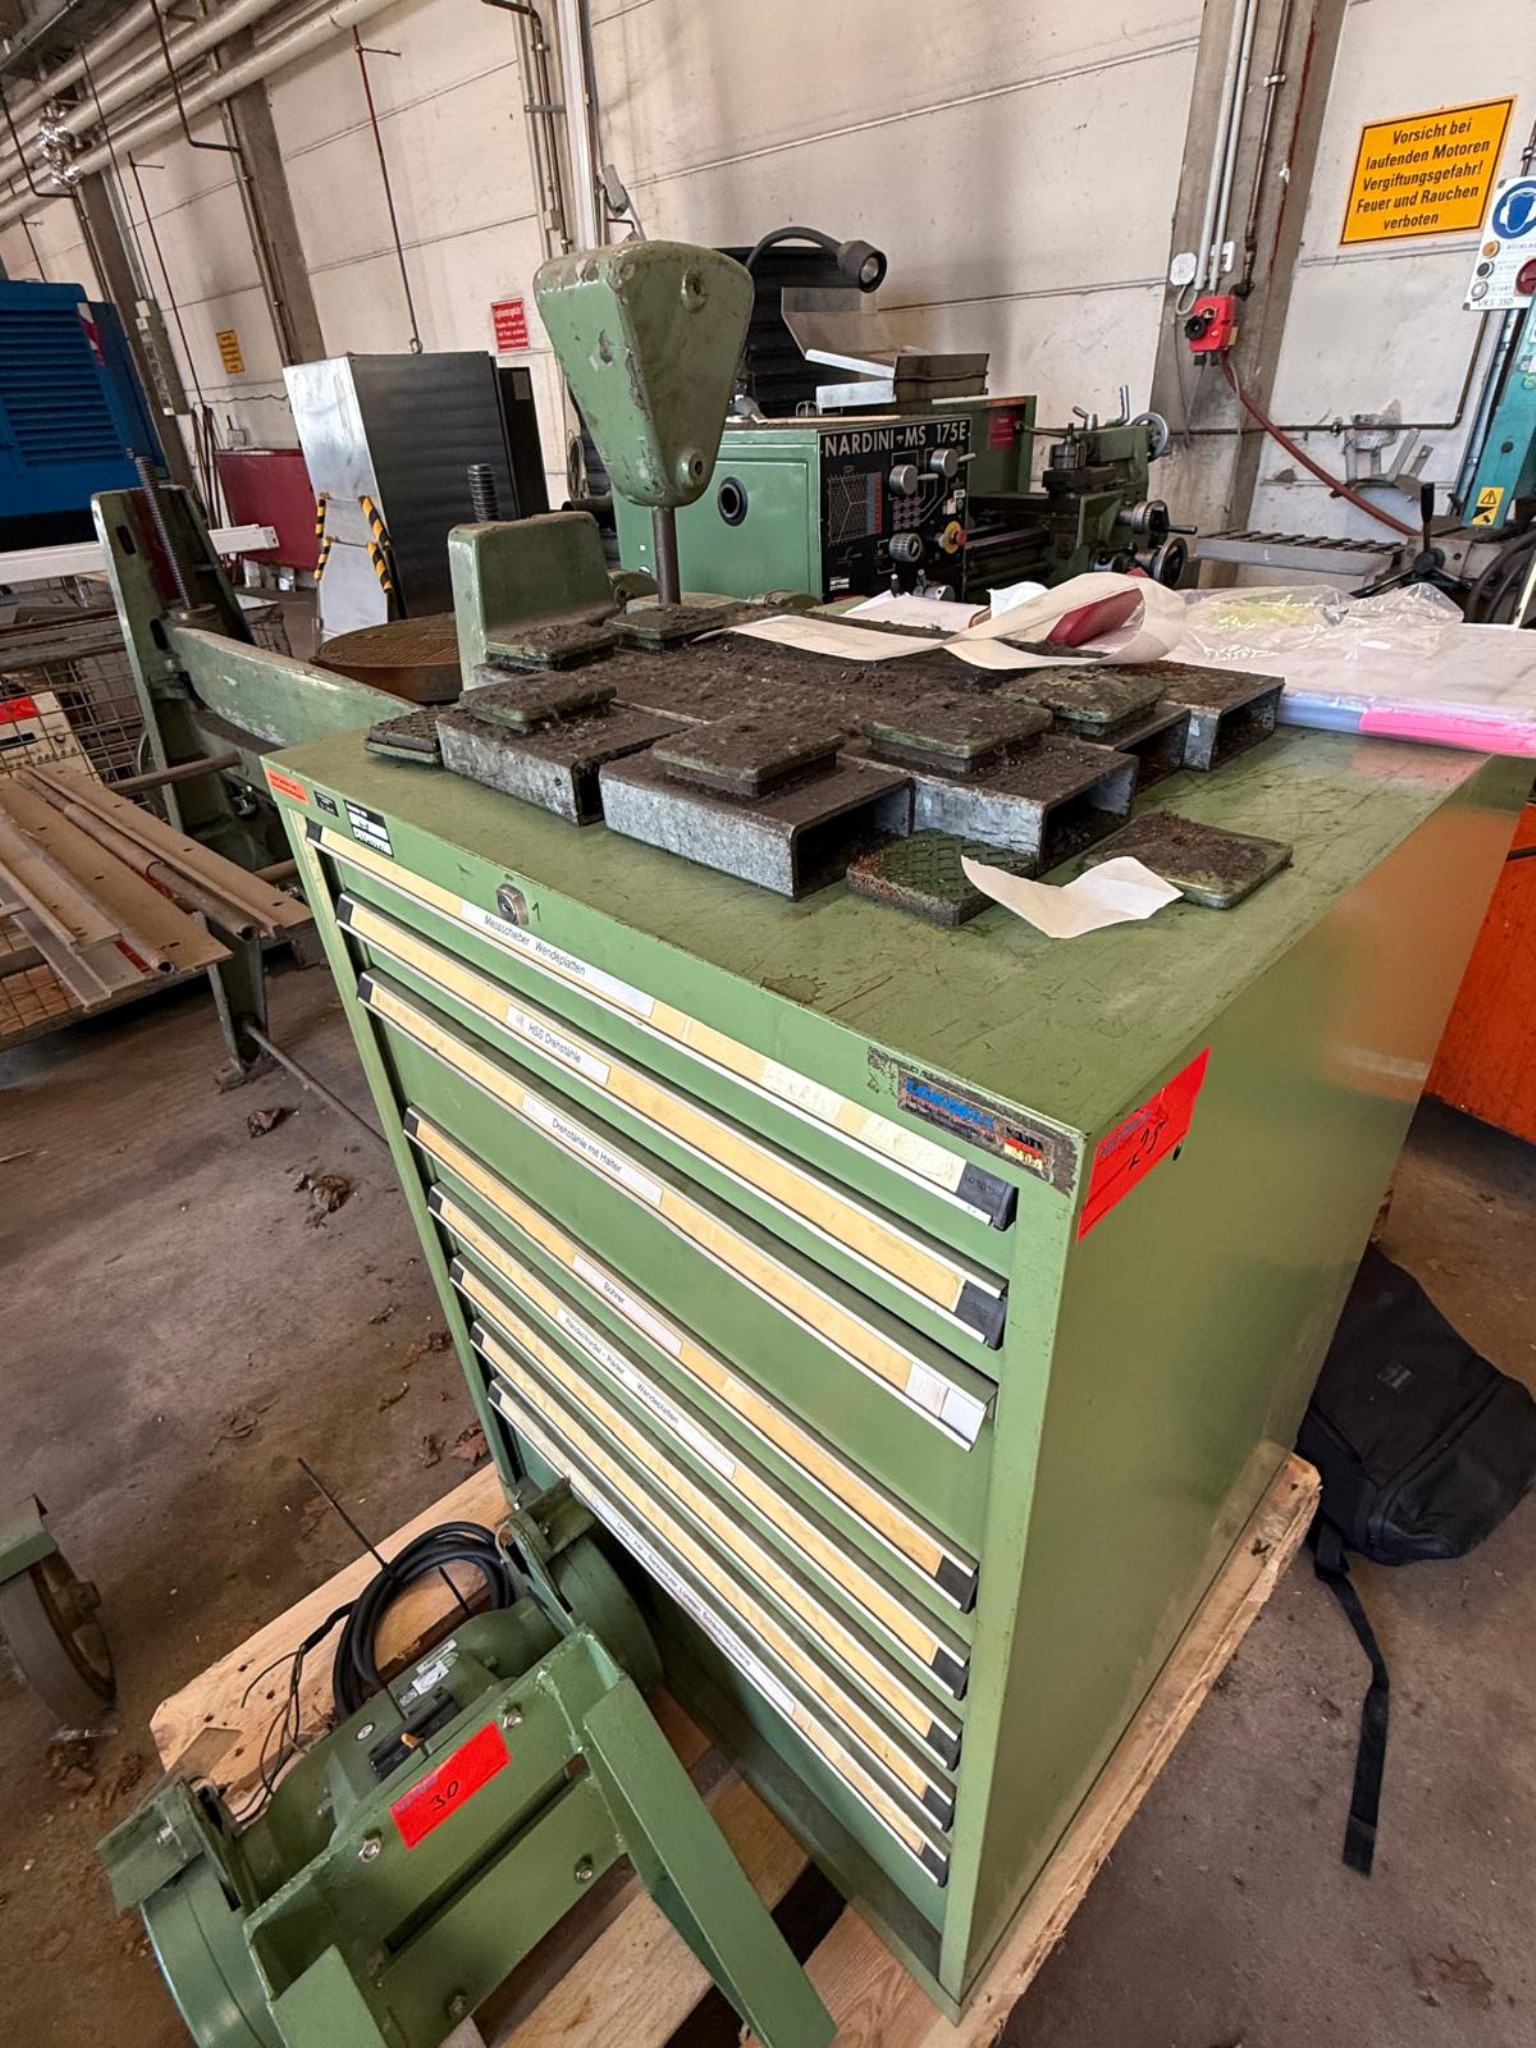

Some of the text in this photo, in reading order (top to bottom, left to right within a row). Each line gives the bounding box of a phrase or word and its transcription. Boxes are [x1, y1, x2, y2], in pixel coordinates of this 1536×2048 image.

[1393, 118, 1473, 145] Vorsicht bei
[1365, 140, 1490, 171] laufenden Motoren
[1363, 160, 1484, 192] Vergiftungsgefahr!
[1356, 185, 1479, 215] Feuer und Rauchen
[1383, 213, 1439, 231] verboten
[936, 421, 966, 442] 175E
[429, 1780, 460, 1812] 30
